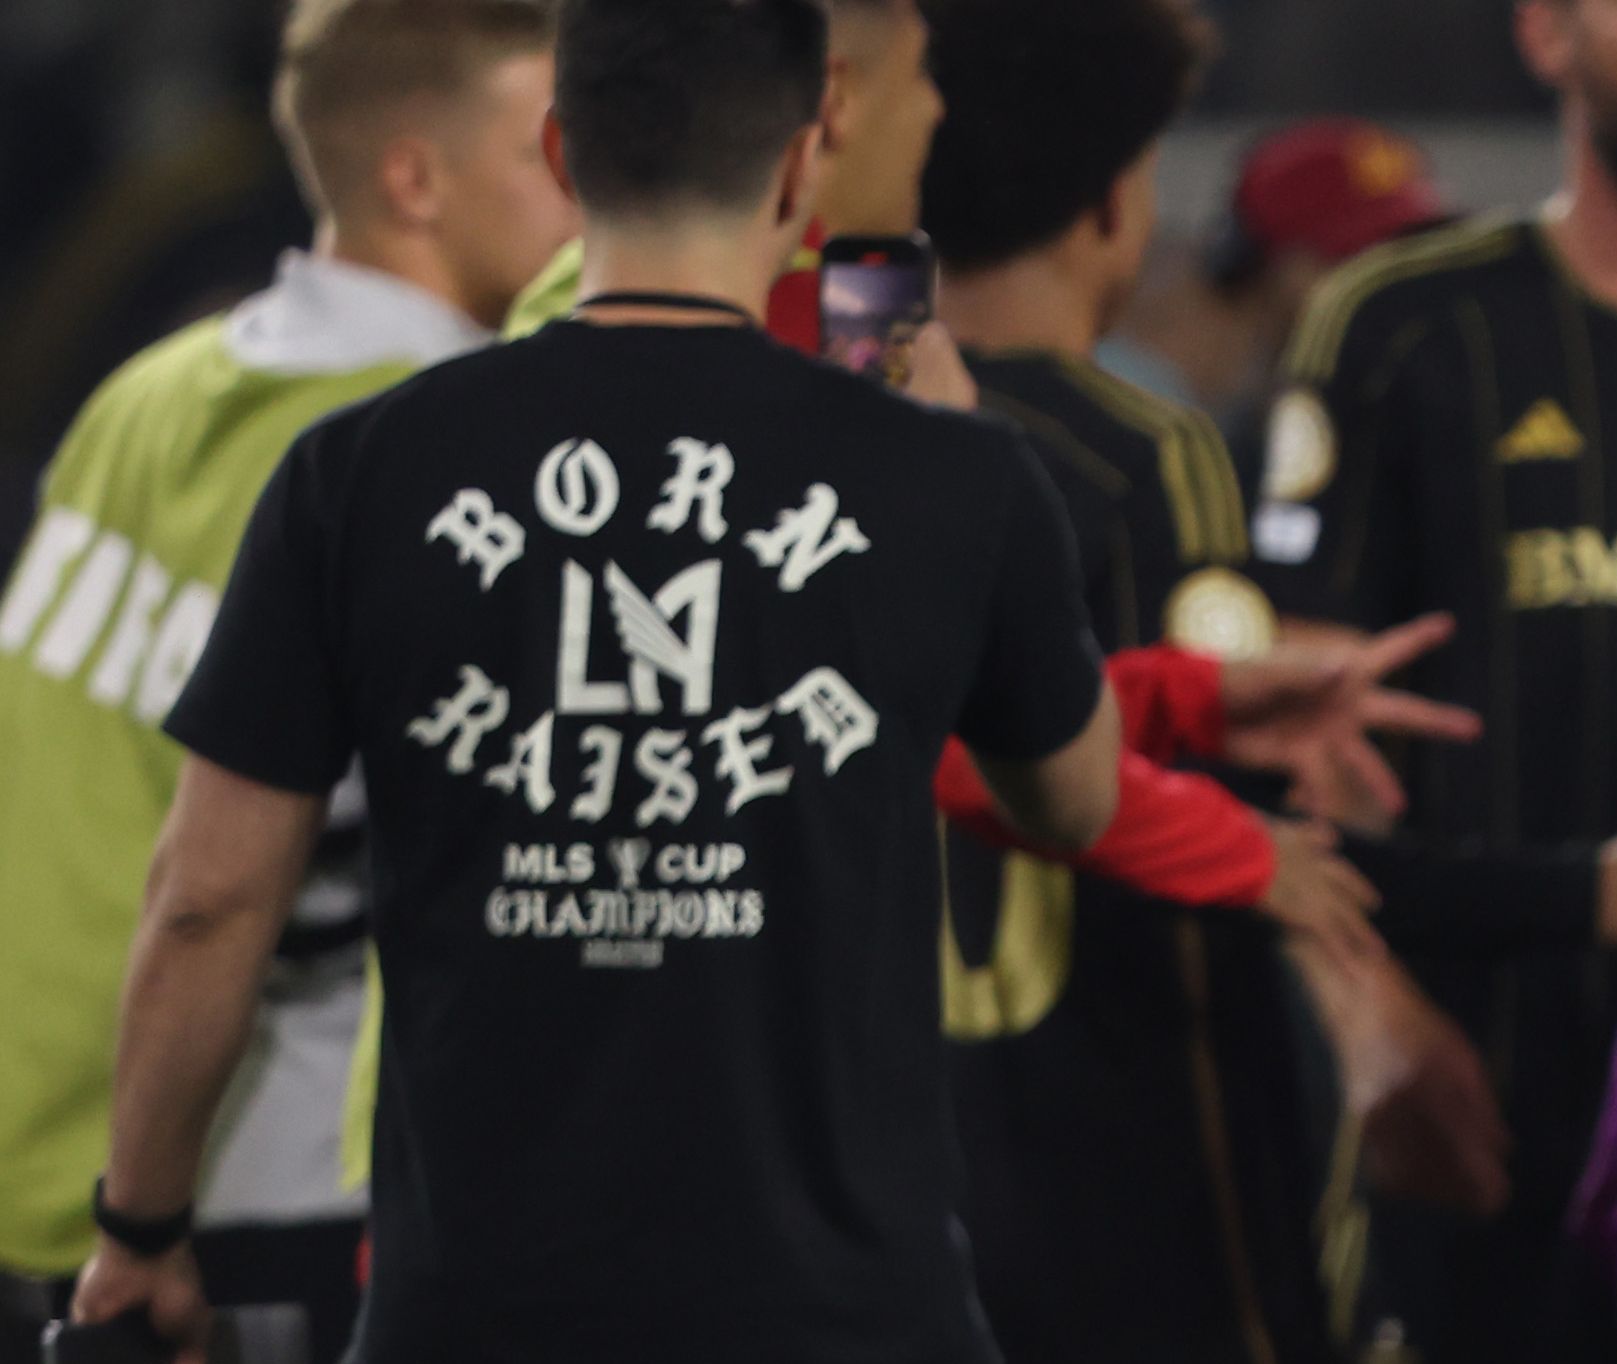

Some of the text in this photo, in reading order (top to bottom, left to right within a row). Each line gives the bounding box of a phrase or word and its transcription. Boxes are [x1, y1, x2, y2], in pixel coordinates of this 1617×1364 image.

[425, 436, 872, 592] BORN
[407, 664, 880, 828] RAISED
[485, 886, 765, 938] CHAMPIONS
[503, 842, 747, 883] MLS CUP
